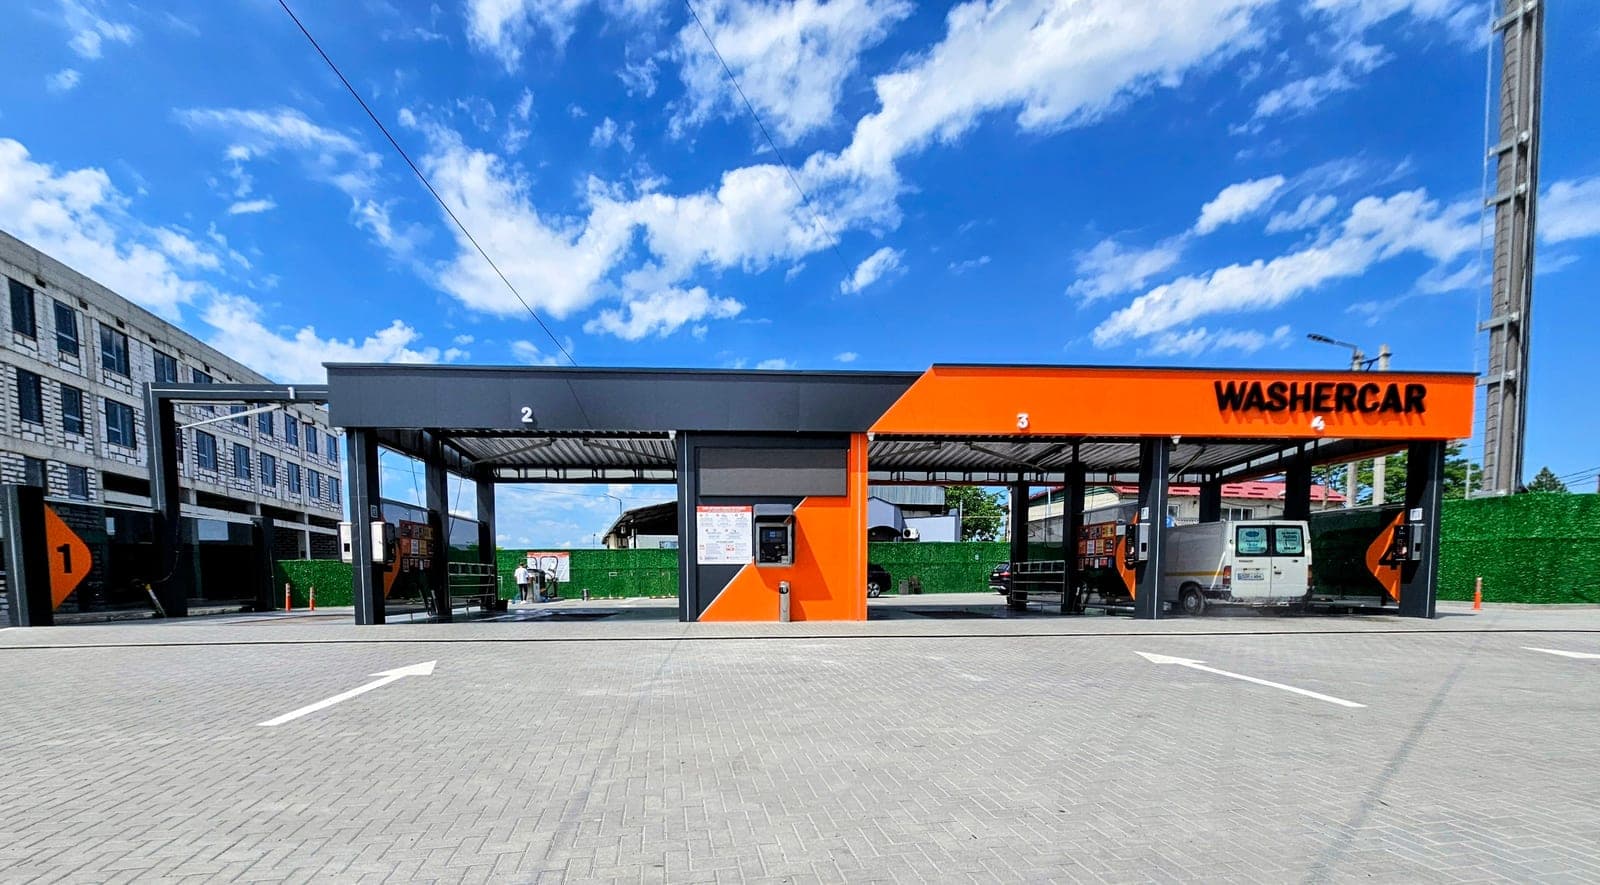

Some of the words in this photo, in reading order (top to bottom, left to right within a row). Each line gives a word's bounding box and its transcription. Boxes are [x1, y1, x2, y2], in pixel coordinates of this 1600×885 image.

[1214, 380, 1427, 414] WASHERCAR
[521, 406, 533, 423] 2
[1016, 412, 1029, 429] 3
[1311, 415, 1325, 431] 4
[56, 543, 72, 574] 1
